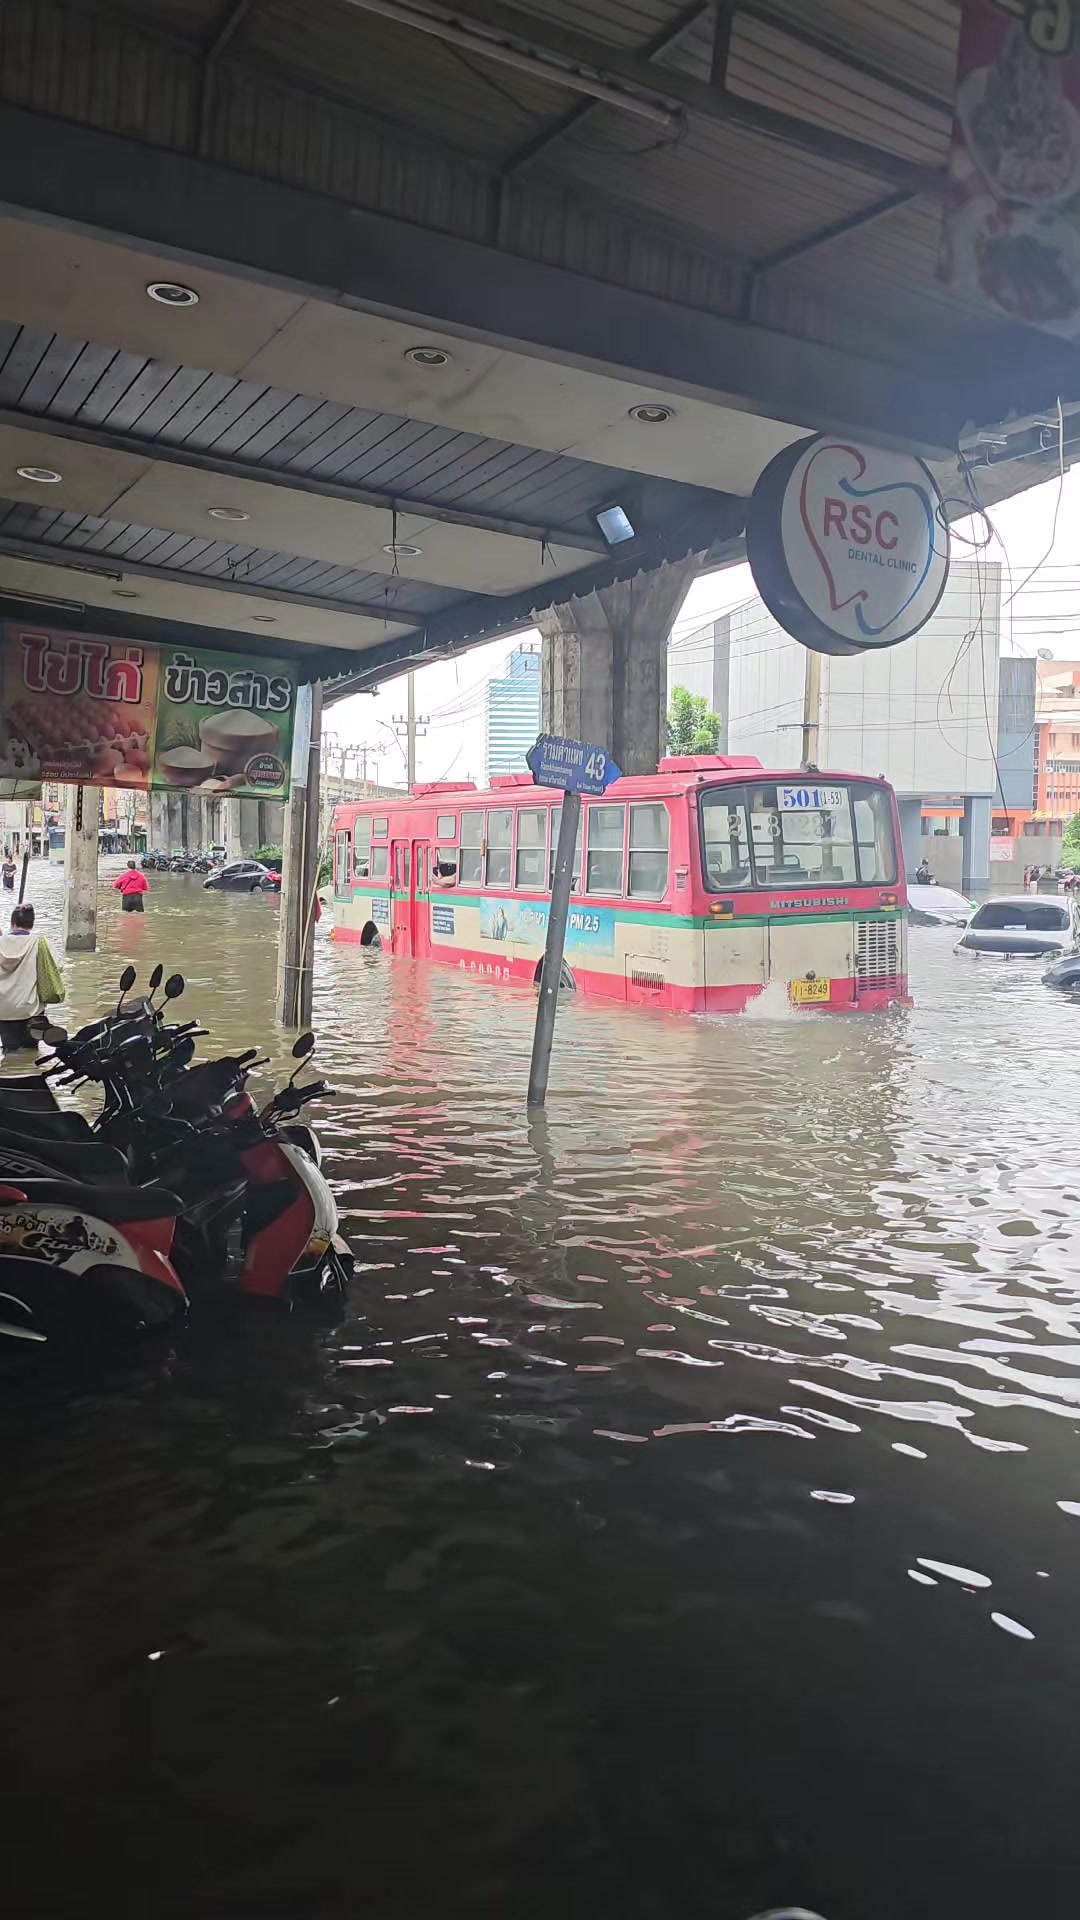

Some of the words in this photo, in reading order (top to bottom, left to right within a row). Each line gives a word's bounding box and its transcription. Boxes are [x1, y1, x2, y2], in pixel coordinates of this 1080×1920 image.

[823, 497, 899, 550] RSC
[848, 548, 885, 567] DENTAL
[887, 558, 917, 574] CLINIC
[19, 633, 143, 702] ไข่ไก่
[164, 653, 292, 711] ข้าวสาร
[542, 740, 583, 766] รามคำแหง
[585, 752, 606, 780] 43
[783, 788, 821, 808] 501
[820, 790, 843, 807] (1-53)
[770, 897, 849, 909] MITSUBISHI
[570, 913, 584, 930] PM
[584, 914, 600, 932] 2.5
[34, 1236, 84, 1251] Fino
